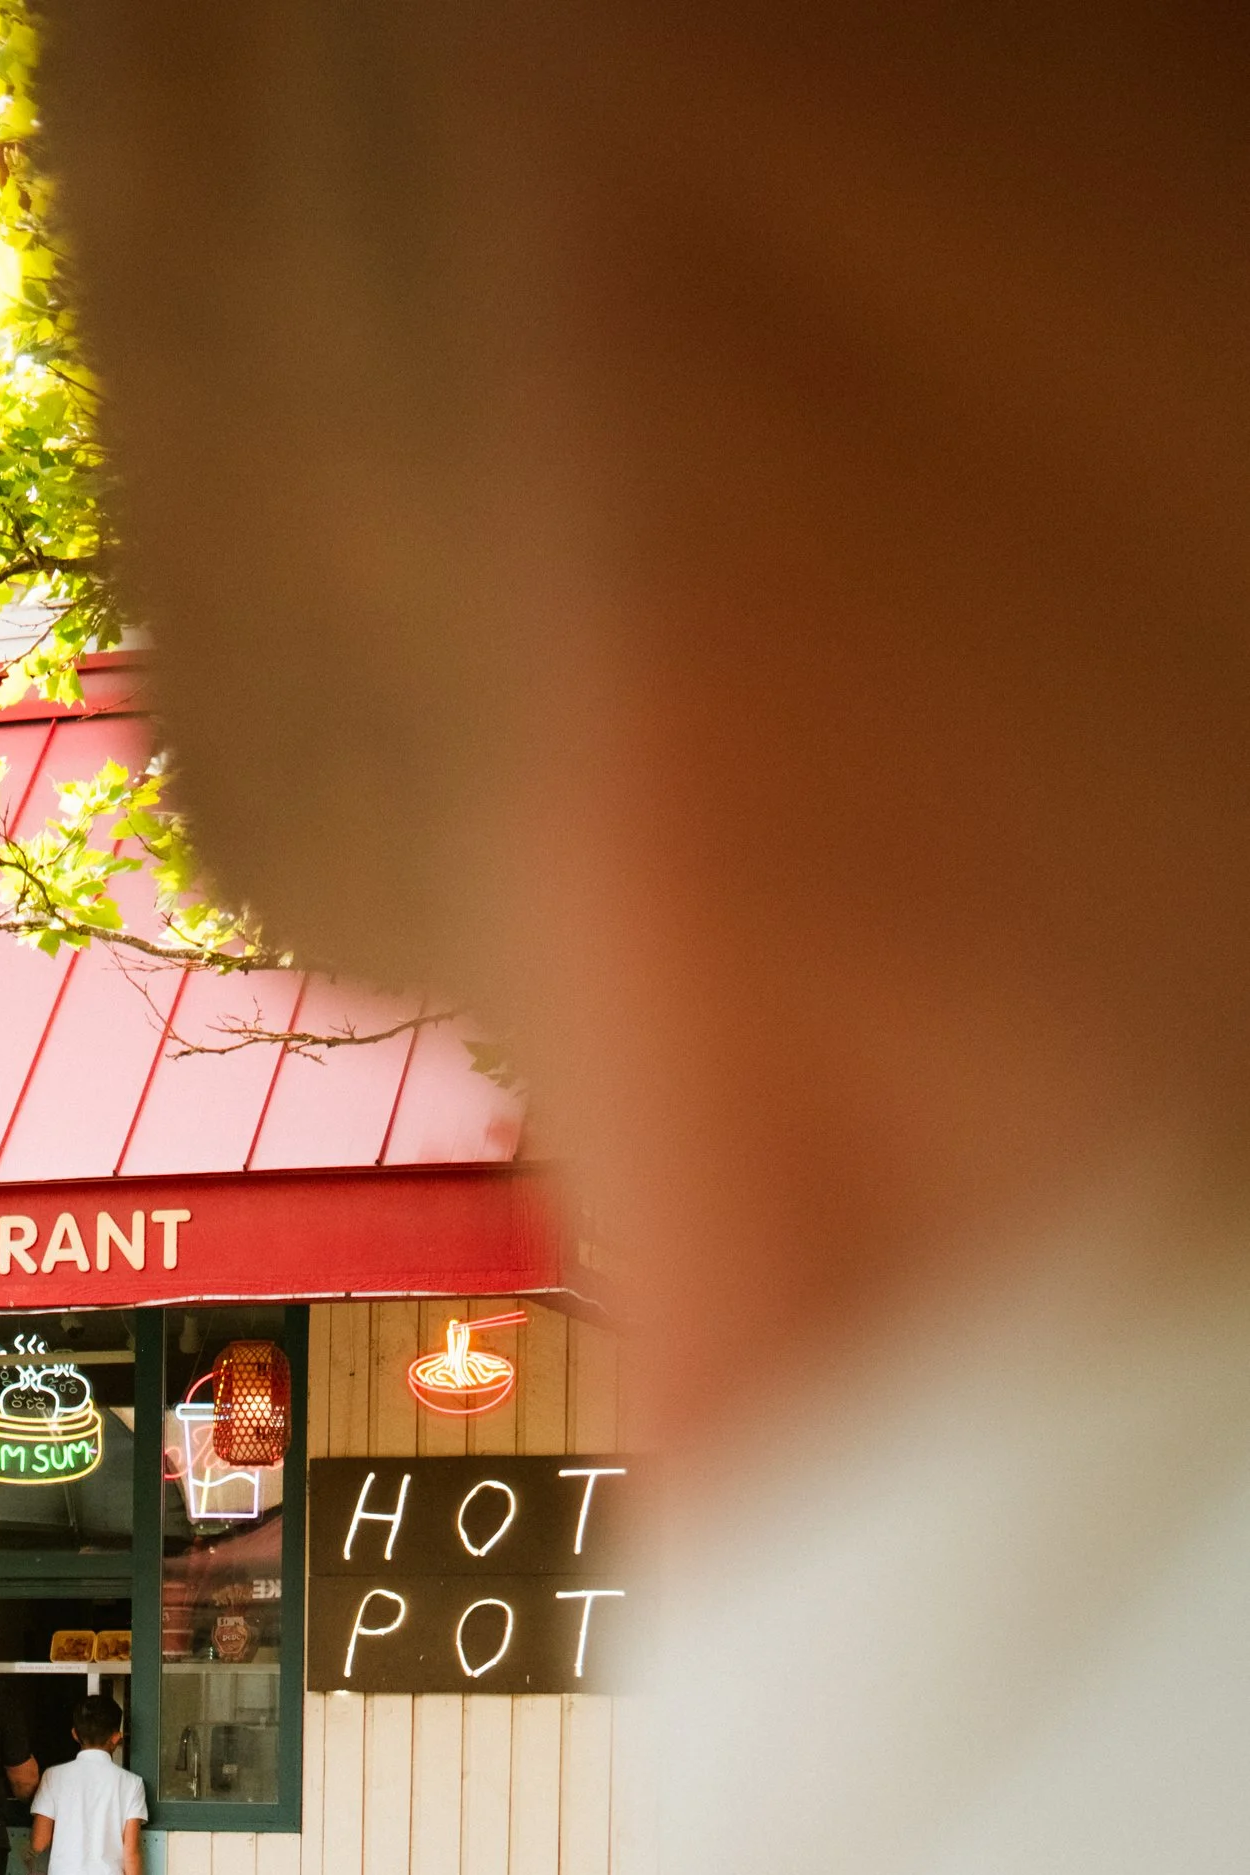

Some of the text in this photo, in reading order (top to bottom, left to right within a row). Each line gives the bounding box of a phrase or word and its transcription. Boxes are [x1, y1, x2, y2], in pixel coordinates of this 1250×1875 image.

[32, 1439, 91, 1473] SUM
[343, 1468, 627, 1562] HOT
[343, 1588, 627, 1680] POT
